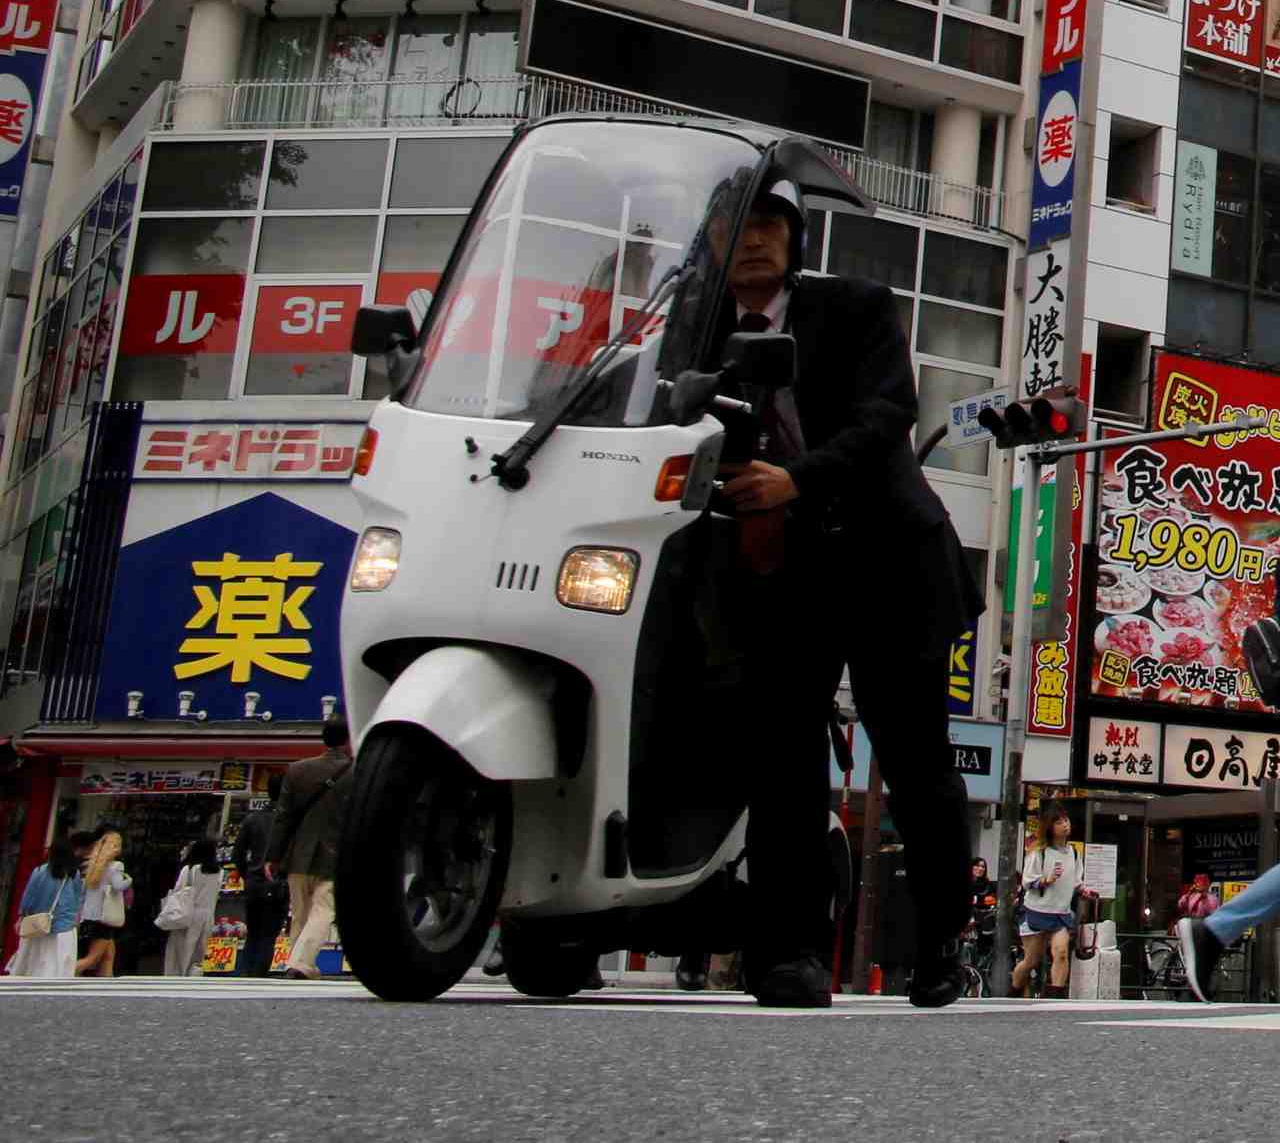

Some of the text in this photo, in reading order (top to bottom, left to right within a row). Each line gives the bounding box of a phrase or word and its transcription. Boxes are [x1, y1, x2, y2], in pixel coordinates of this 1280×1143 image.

[1196, 15, 1253, 58] 本舗
[1040, 116, 1074, 166] 薬
[155, 290, 215, 345] ル
[280, 297, 345, 336] 3F
[142, 429, 358, 474] ミネドラッ
[581, 450, 641, 464] HONDA
[173, 552, 323, 684] 薬
[1132, 654, 1240, 695] 食べ放題
[111, 770, 216, 789] ミネドラッグ
[953, 748, 983, 771] RA
[1093, 748, 1153, 775] 中華食堂
